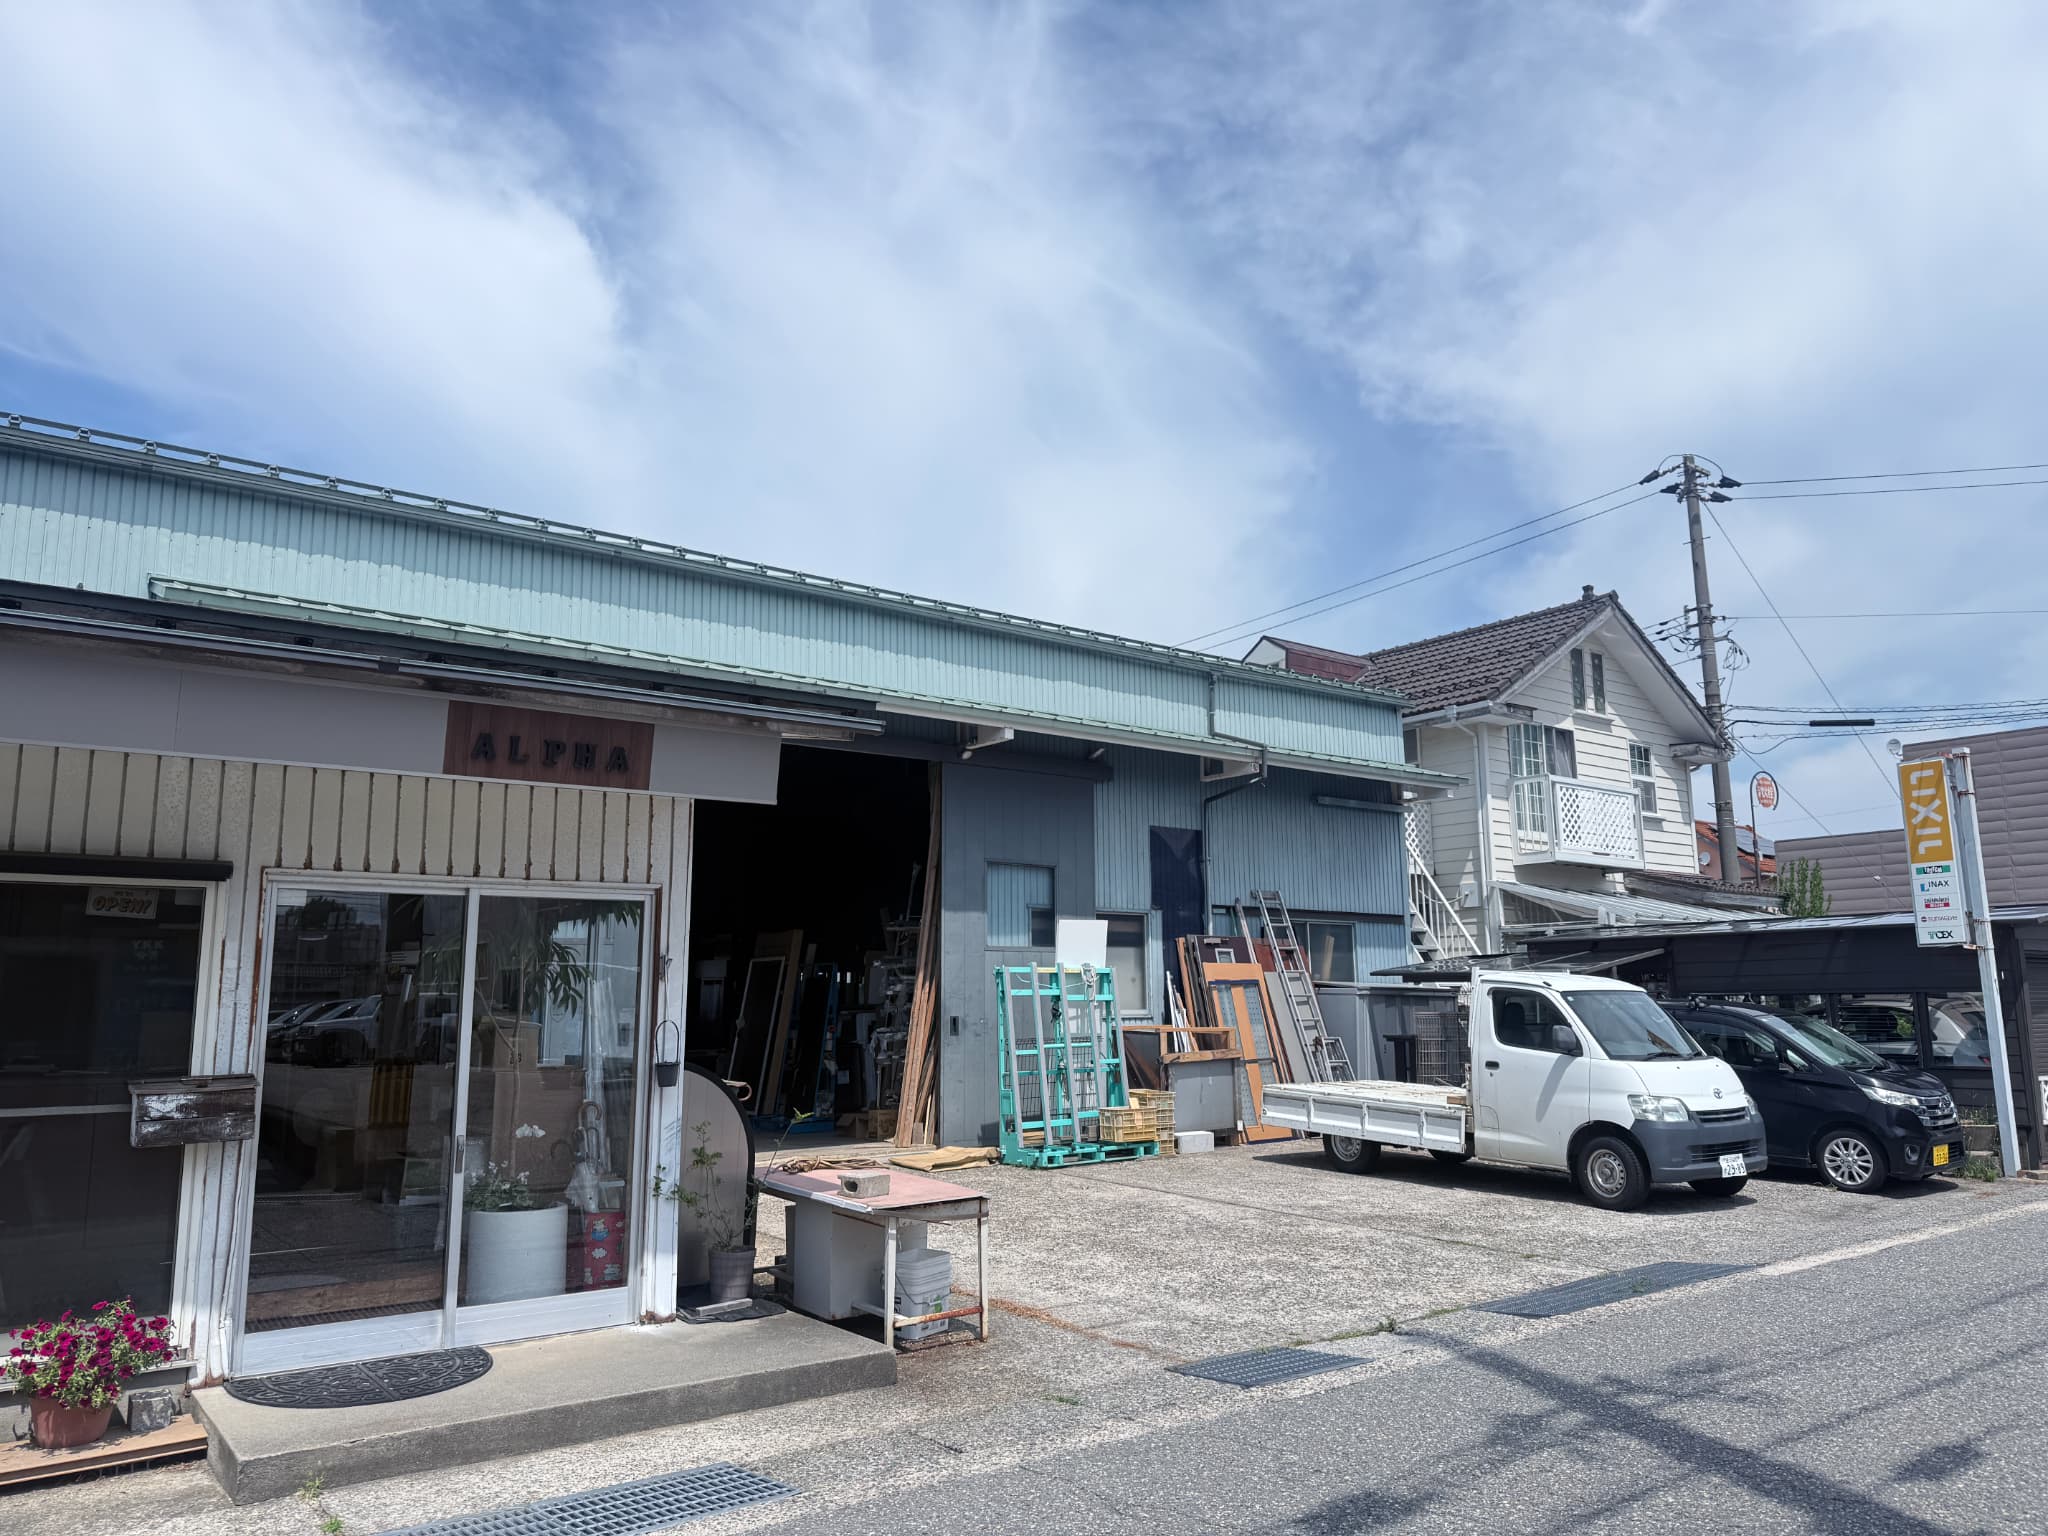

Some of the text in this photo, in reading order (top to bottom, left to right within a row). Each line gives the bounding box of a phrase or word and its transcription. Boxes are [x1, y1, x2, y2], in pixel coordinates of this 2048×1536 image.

[470, 731, 630, 773] ALPHA
[1910, 768, 1943, 855] LIXIL
[1928, 930, 1954, 940] TOEX
